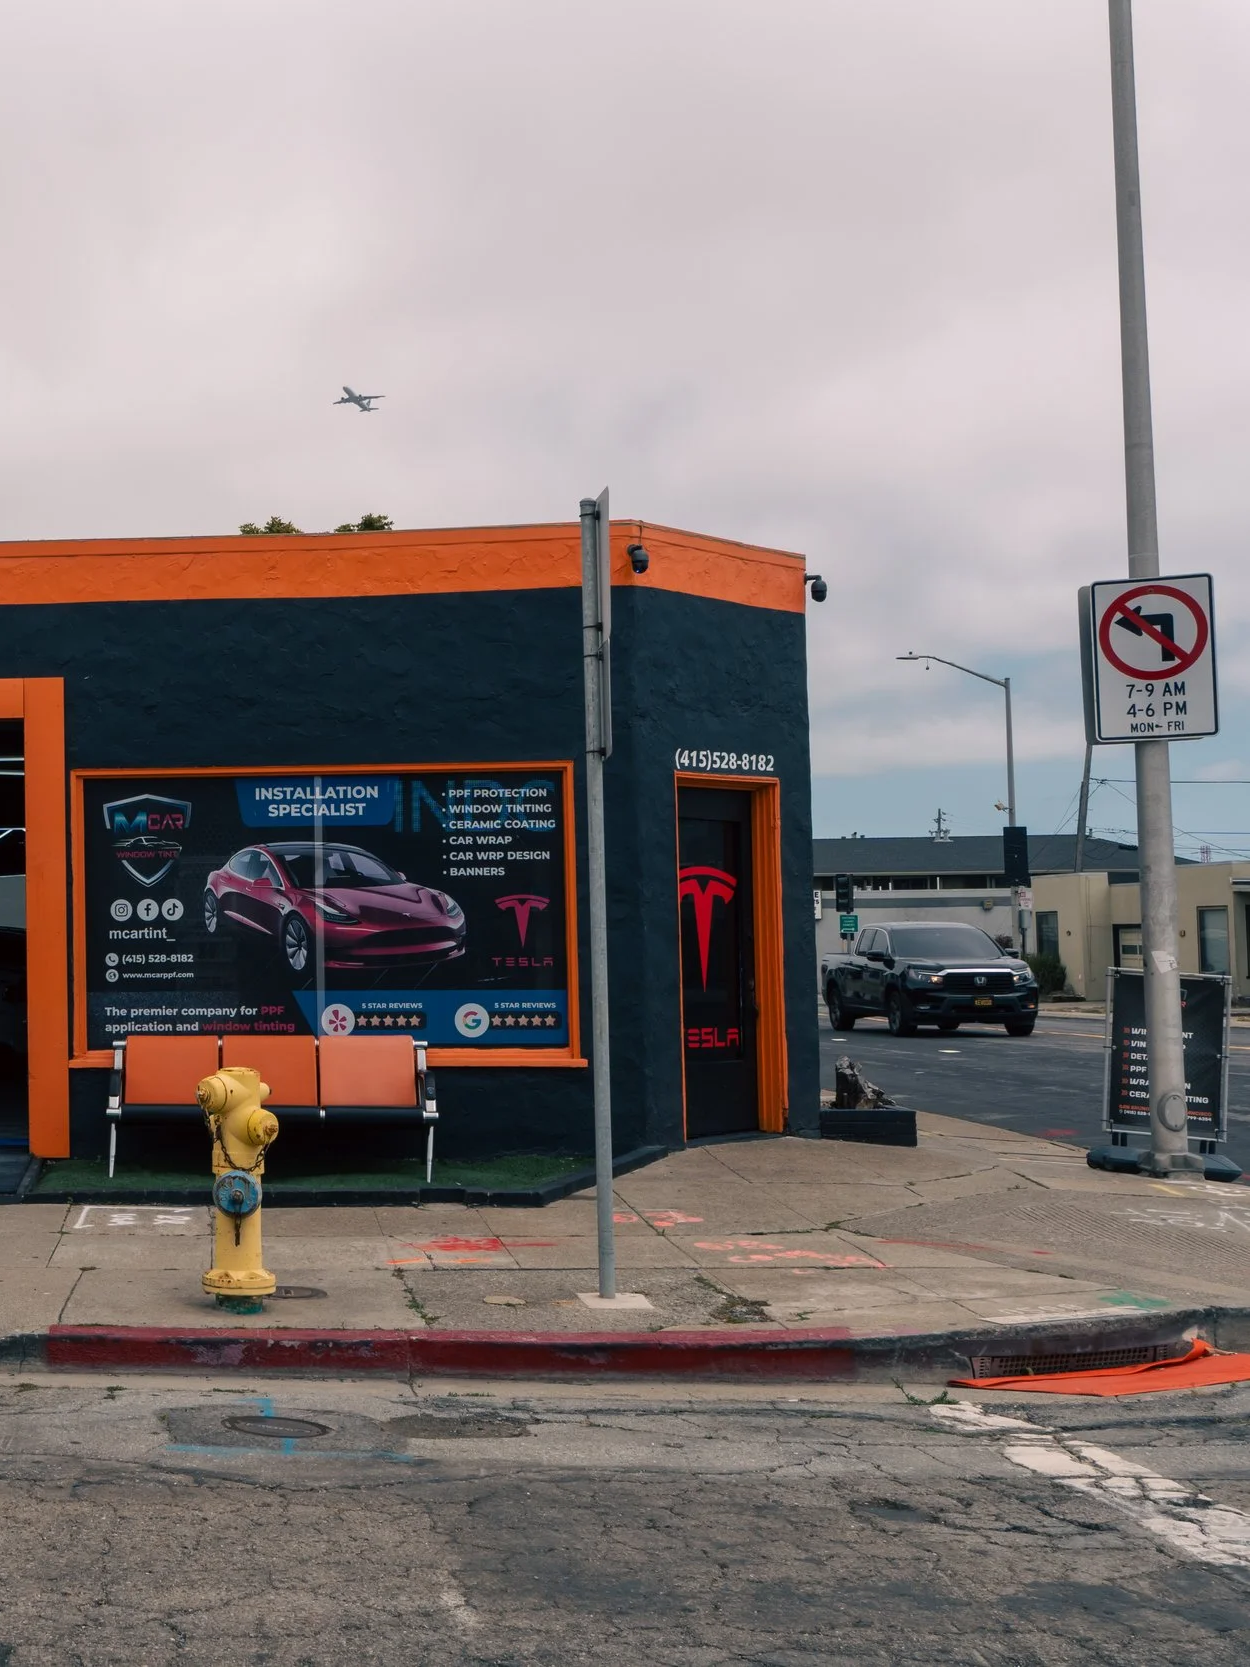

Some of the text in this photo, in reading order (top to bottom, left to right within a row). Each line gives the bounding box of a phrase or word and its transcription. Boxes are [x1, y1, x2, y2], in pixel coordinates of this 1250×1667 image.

[1126, 681, 1186, 699] 7-9 AM
[1127, 701, 1187, 718] 4-6 PM
[1167, 721, 1185, 731] FRI
[675, 748, 775, 771] (415)528-8182
[255, 785, 379, 800] INSTALLATION
[448, 788, 547, 798] PPF PROTECTION
[268, 803, 366, 817] SPECIALIST
[449, 804, 552, 814] WINDOW TINTING
[449, 819, 556, 829] CERAMIC COATING
[449, 835, 513, 845] CAR WRAP
[116, 850, 155, 859] WINDOW
[449, 851, 551, 861] CAR WRP DESIGN
[450, 867, 506, 876] BANNERS
[109, 927, 176, 942] mcartint_
[122, 954, 194, 965] (415) 528-8182
[491, 957, 554, 967] TESLA
[122, 971, 194, 979] www.mcarppf.com
[104, 1005, 285, 1018] The premier company for PPF
[105, 1021, 295, 1034] application and window tinting
[687, 1027, 739, 1048] ESLA
[1130, 1052, 1148, 1061] DET
[1130, 1065, 1147, 1073] PPF
